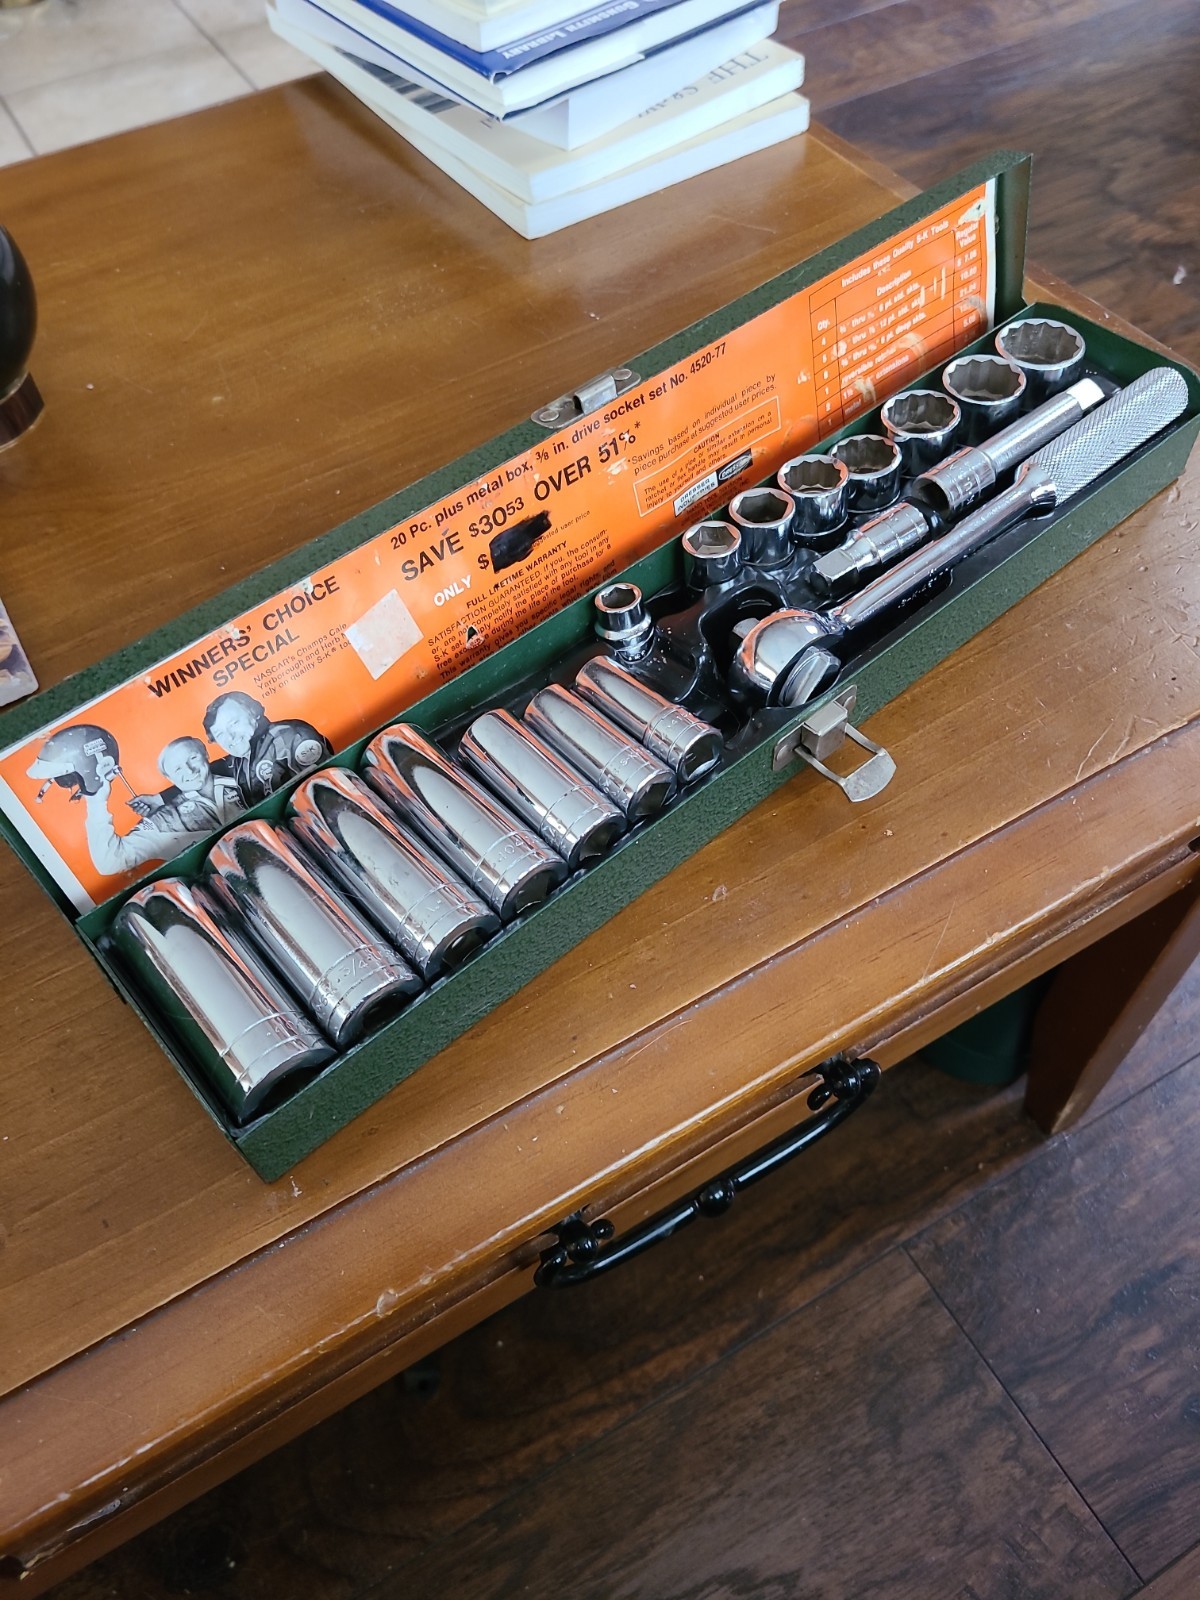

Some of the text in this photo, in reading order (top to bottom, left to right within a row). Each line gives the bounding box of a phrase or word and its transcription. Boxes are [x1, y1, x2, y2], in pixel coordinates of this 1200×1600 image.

[502, 28, 566, 60] LIBRARY
[841, 217, 949, 289] Includes these Quality S-K Tools
[955, 219, 978, 242] Regular
[959, 231, 976, 249] Value
[876, 267, 912, 298] Description
[895, 318, 911, 337] deep
[841, 357, 873, 385] reversible
[875, 352, 909, 381] extensions
[633, 379, 776, 476] piece purchase at suggested user prices.
[667, 425, 689, 445] based
[692, 417, 700, 428] on
[703, 392, 737, 419] individual
[741, 378, 761, 397] piece
[766, 371, 776, 385] by
[390, 530, 407, 550] 20
[409, 515, 432, 538] Pc.
[434, 498, 464, 526] plus
[466, 474, 503, 505] metal
[505, 457, 533, 484] box,
[552, 436, 568, 455] in.
[570, 417, 600, 444] drive
[603, 391, 645, 426] socket
[648, 381, 666, 401] set
[669, 368, 687, 388] No.
[689, 342, 727, 375] 4520-77
[644, 482, 656, 495] The
[658, 476, 670, 487] use
[671, 469, 678, 479] of
[698, 450, 703, 458] or
[706, 436, 726, 453] similar
[727, 418, 755, 440] extension
[757, 413, 764, 422] on
[645, 484, 667, 503] ratchet
[669, 480, 675, 488] or
[687, 456, 706, 473] handle
[708, 448, 720, 460] may
[721, 436, 738, 451] result
[739, 431, 745, 440] in
[747, 415, 772, 437] personal
[693, 431, 720, 454] CAUTION
[666, 490, 672, 498] to
[674, 472, 694, 493] yourself
[695, 464, 706, 475] and
[677, 481, 715, 511] INDUSTRIES
[680, 477, 709, 502] DRESSER
[400, 530, 464, 583] SAVE
[533, 453, 591, 504] OVER
[560, 508, 590, 531] user price
[427, 603, 487, 647] SATISFACTION
[566, 544, 579, 558] the
[433, 573, 473, 608] ONLY
[433, 648, 448, 662] S-K
[493, 606, 514, 624] notify
[515, 597, 527, 609] the
[529, 583, 549, 601] place
[550, 575, 558, 586] of
[560, 553, 594, 581] purchase
[595, 547, 604, 559] for
[606, 542, 611, 550] a
[443, 634, 456, 646] are
[471, 597, 511, 629] completely
[511, 577, 542, 602] satisfied
[543, 566, 558, 581] with
[559, 558, 572, 572] any
[574, 548, 589, 562] tool
[589, 543, 597, 553] in
[598, 535, 609, 548] any
[466, 590, 487, 610] FULL
[525, 539, 568, 572] WARRANTY
[147, 574, 340, 701] WINNERS' CHOICE
[436, 655, 453, 671] free
[490, 615, 514, 636] during
[514, 605, 527, 618] the
[528, 597, 540, 611] life
[541, 591, 549, 602] of
[549, 583, 561, 595] the
[439, 663, 457, 680] This
[458, 640, 492, 668] warranty
[493, 627, 514, 646] gives
[514, 617, 529, 632] you
[530, 597, 558, 622] specific
[559, 584, 577, 601] legal
[602, 558, 615, 572] and
[211, 623, 300, 688] SPECIAL
[253, 653, 296, 683] NASCAR's
[295, 632, 328, 657] Champs
[257, 657, 304, 691] Yarborough
[304, 648, 320, 661] and
[321, 634, 340, 651] Herb
[260, 684, 277, 699] rely
[278, 678, 288, 687] on
[289, 659, 316, 681] quality
